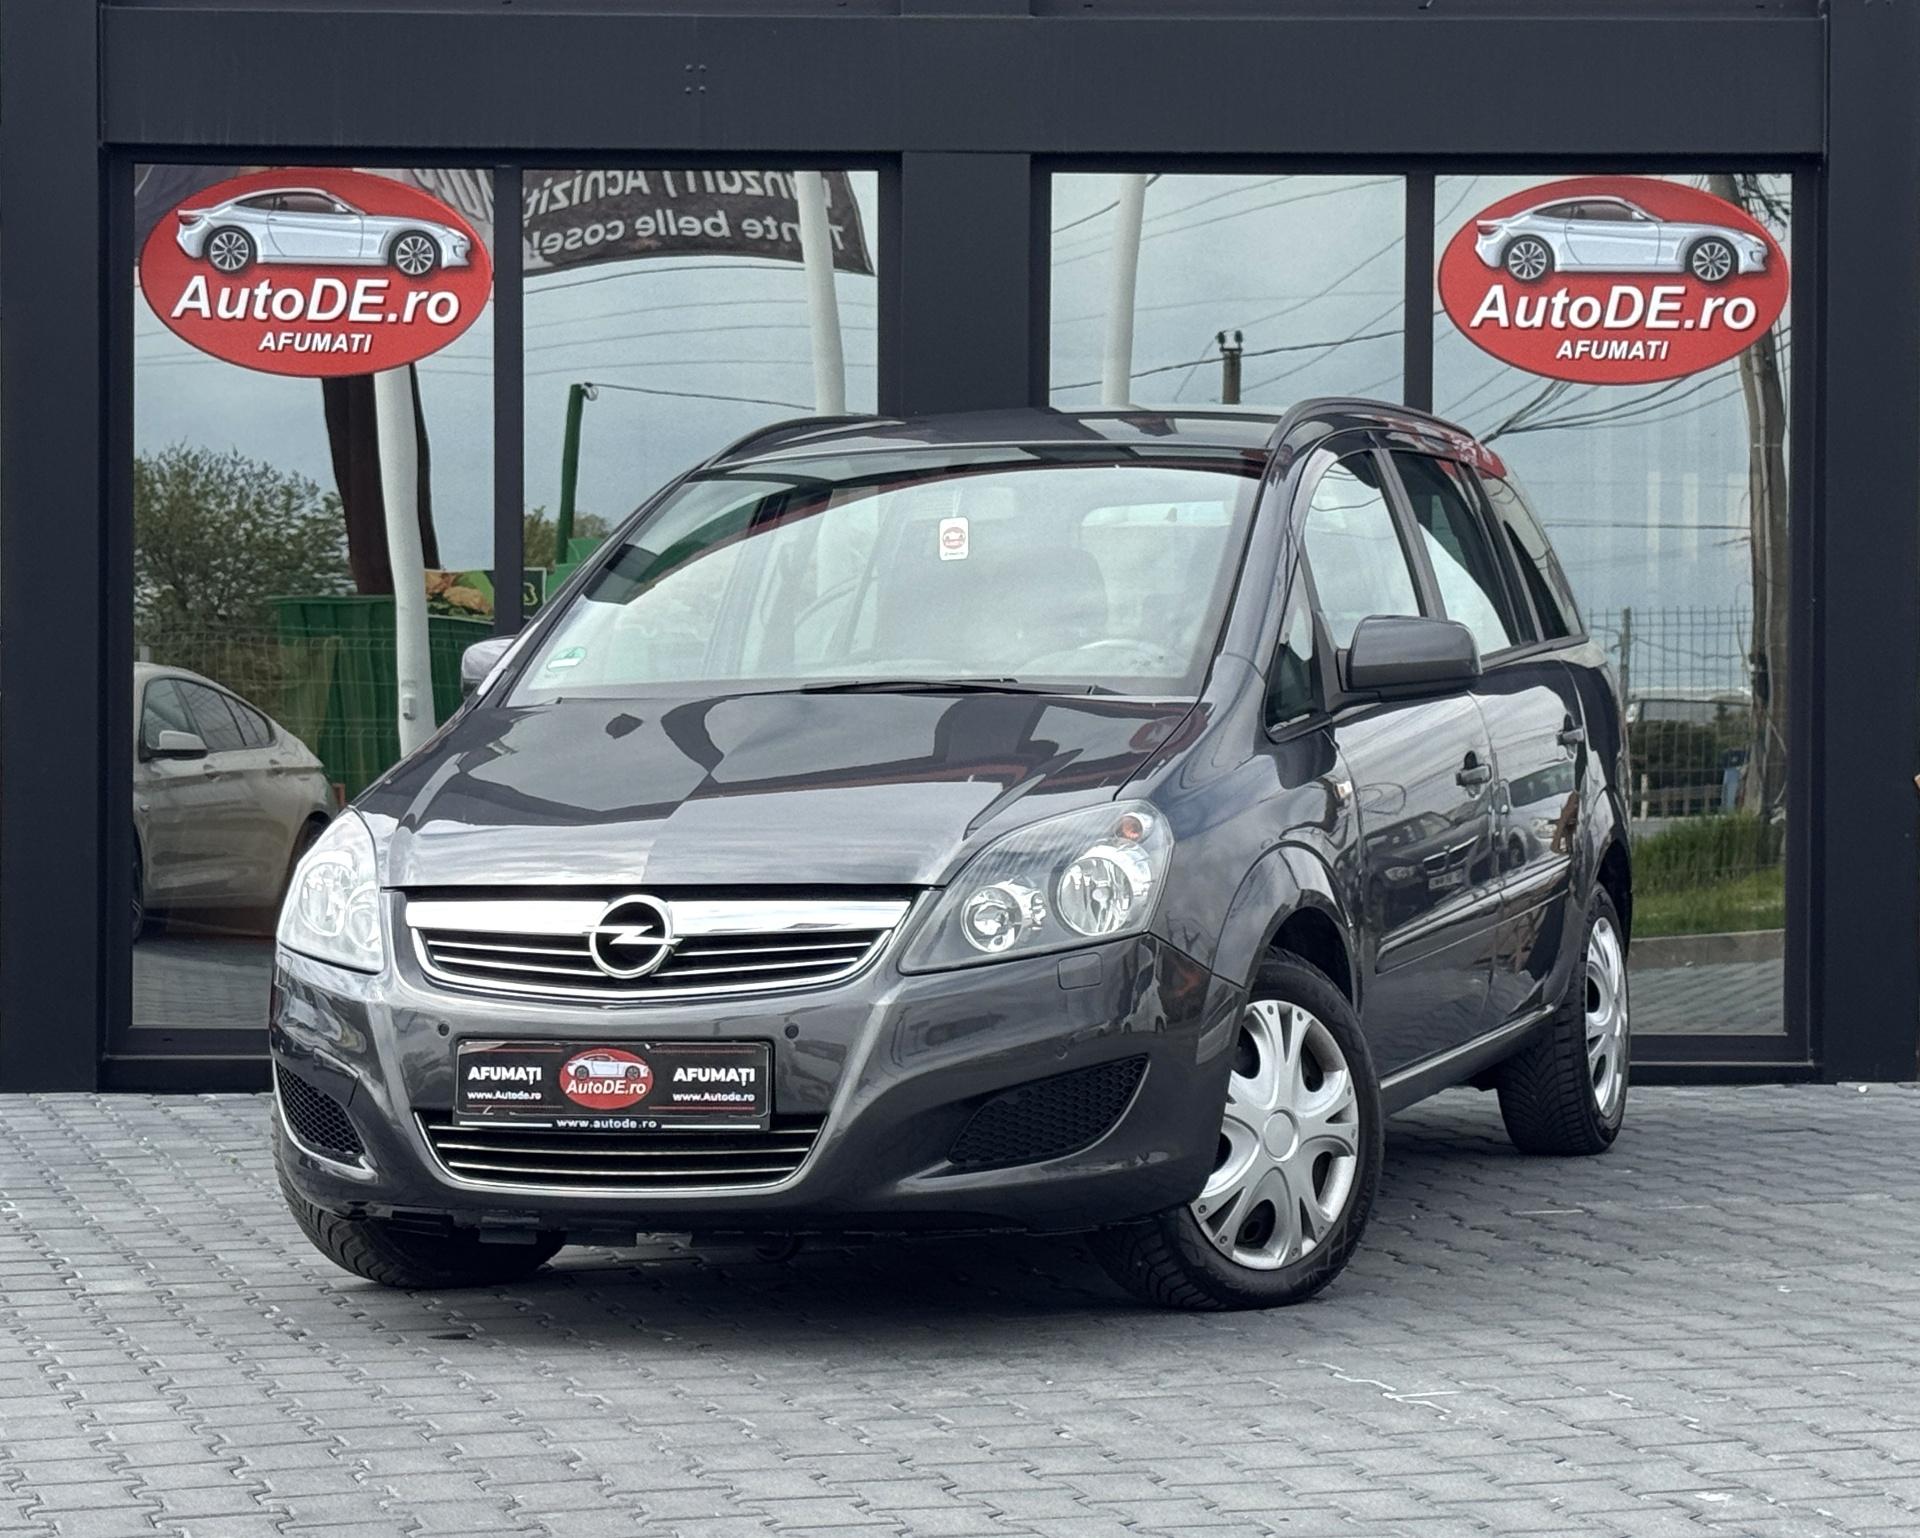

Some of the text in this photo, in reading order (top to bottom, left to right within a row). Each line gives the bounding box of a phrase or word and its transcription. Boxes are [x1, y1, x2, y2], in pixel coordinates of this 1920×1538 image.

[171, 275, 460, 324] AutoDE.ro
[1469, 284, 1757, 331] AutoDE.ro
[258, 331, 372, 353] AFUMATI
[1556, 339, 1669, 361] AFUMATI
[467, 1091, 542, 1100] www.Autode.ro
[565, 1079, 646, 1095] AutoDE.ro
[673, 1092, 755, 1102] www.Autode.ro
[556, 1118, 657, 1129] www.autode.ro
